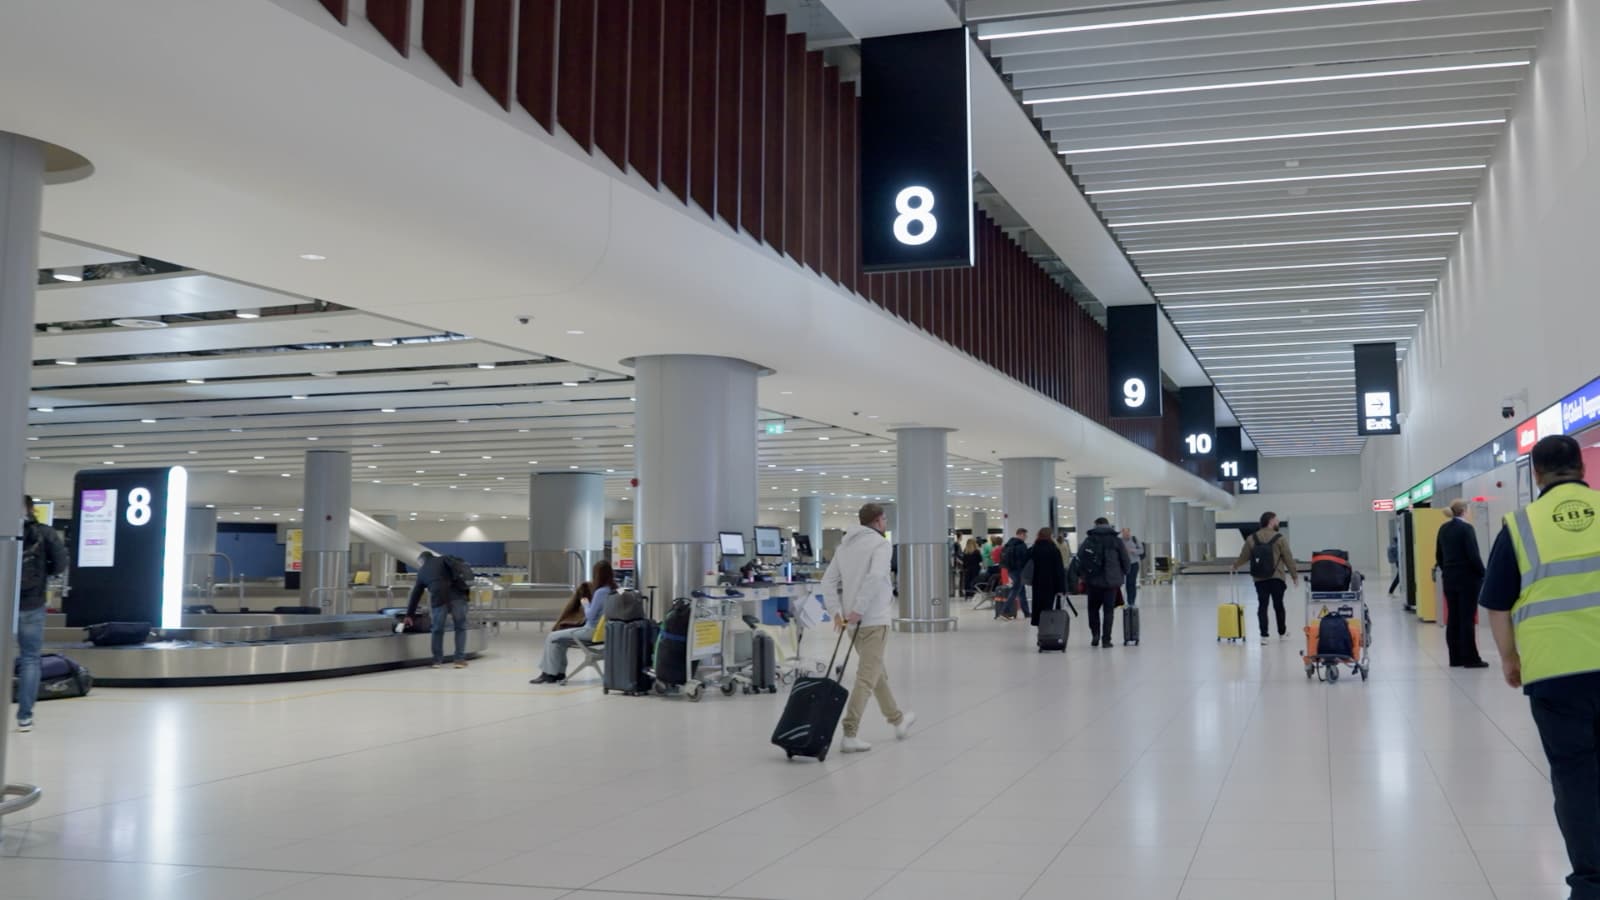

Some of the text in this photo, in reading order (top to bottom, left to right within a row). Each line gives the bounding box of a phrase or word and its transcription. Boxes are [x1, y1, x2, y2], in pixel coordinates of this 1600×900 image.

[893, 185, 938, 246] 8
[1123, 377, 1146, 408] 9
[1365, 417, 1392, 431] Exit
[1185, 433, 1212, 454] 10
[1220, 461, 1238, 477] 11
[1240, 477, 1258, 491] 12
[126, 487, 152, 526] 8
